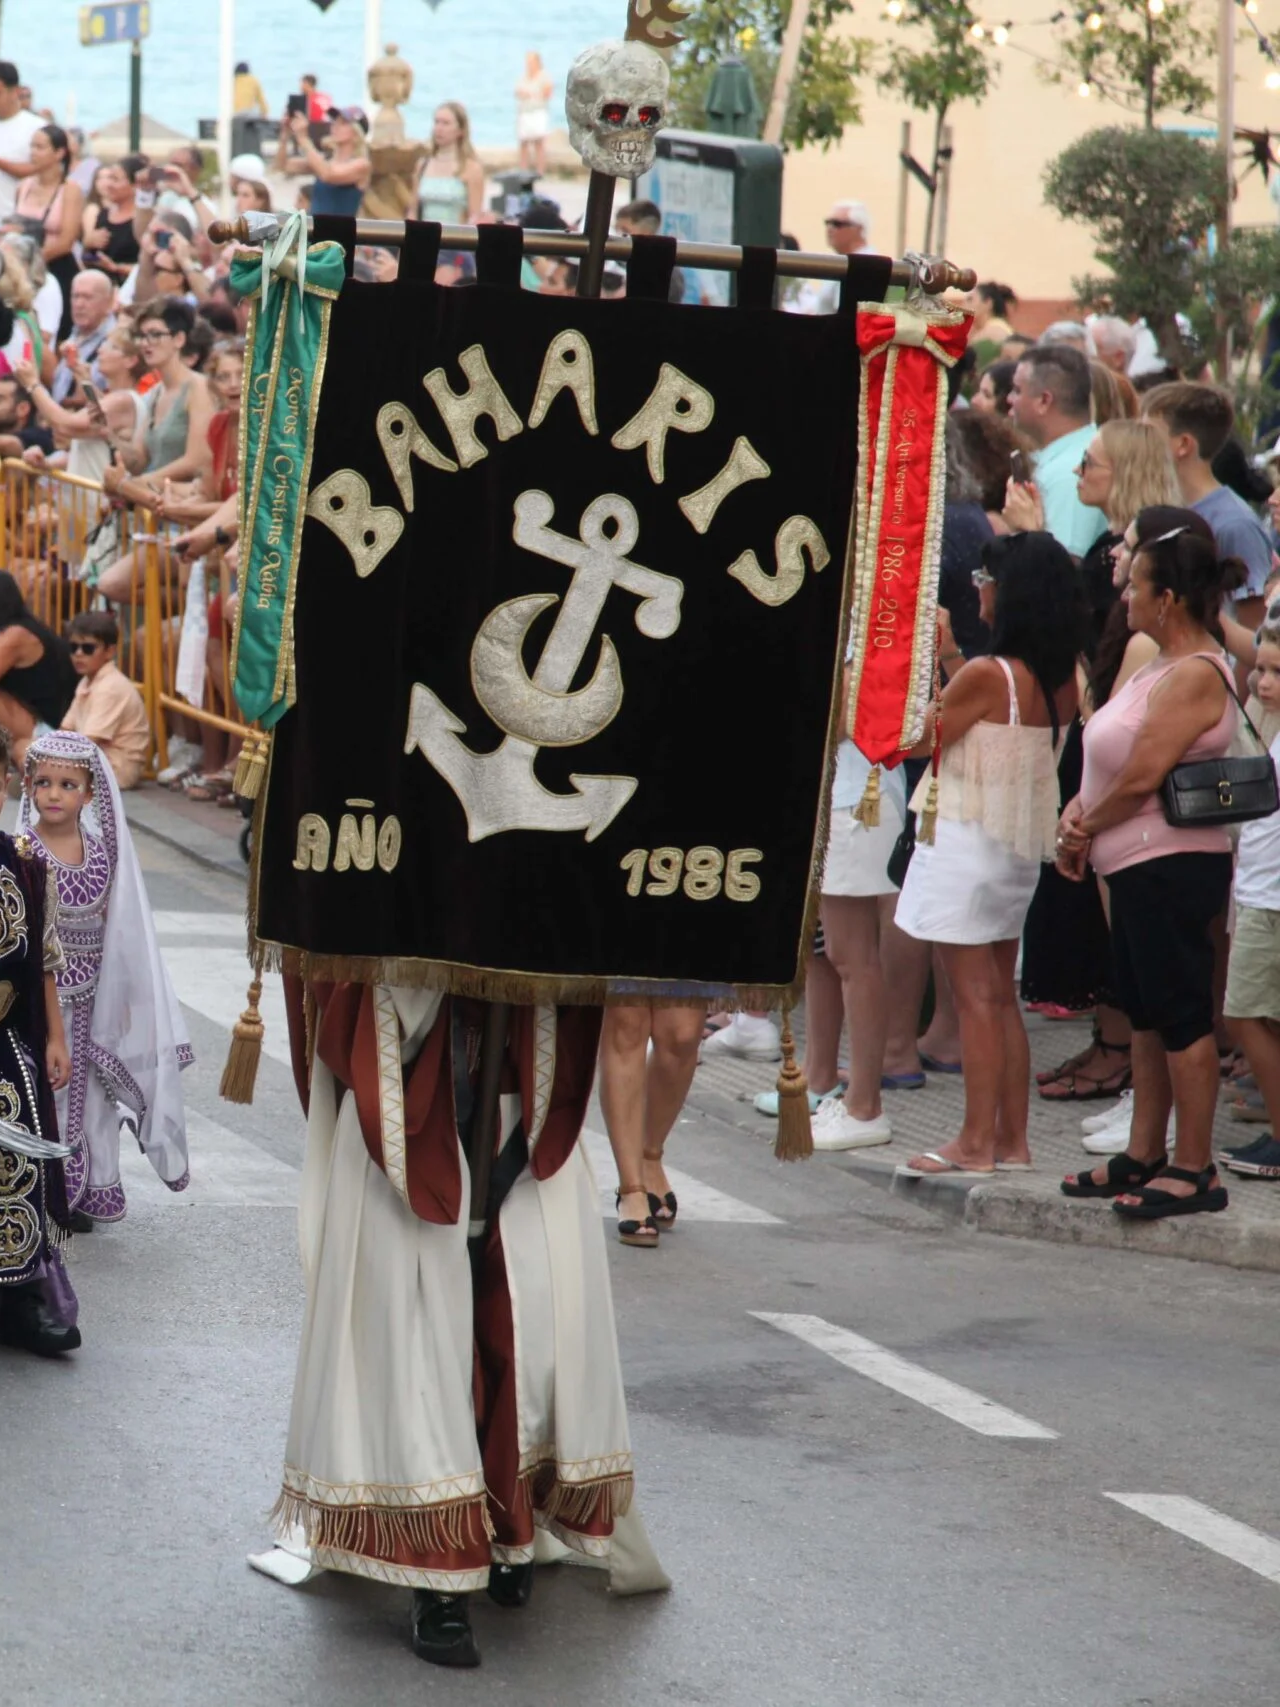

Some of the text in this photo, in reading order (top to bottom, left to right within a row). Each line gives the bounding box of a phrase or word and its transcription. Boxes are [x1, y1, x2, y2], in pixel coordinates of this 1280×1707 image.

[282, 367, 304, 435] Moros
[266, 455, 295, 546] Cristians
[308, 328, 831, 607] BAHARIS
[873, 408, 917, 648] 25 Aniversario 1986-2010
[293, 798, 402, 874] AÑO
[620, 845, 763, 903] 1986
